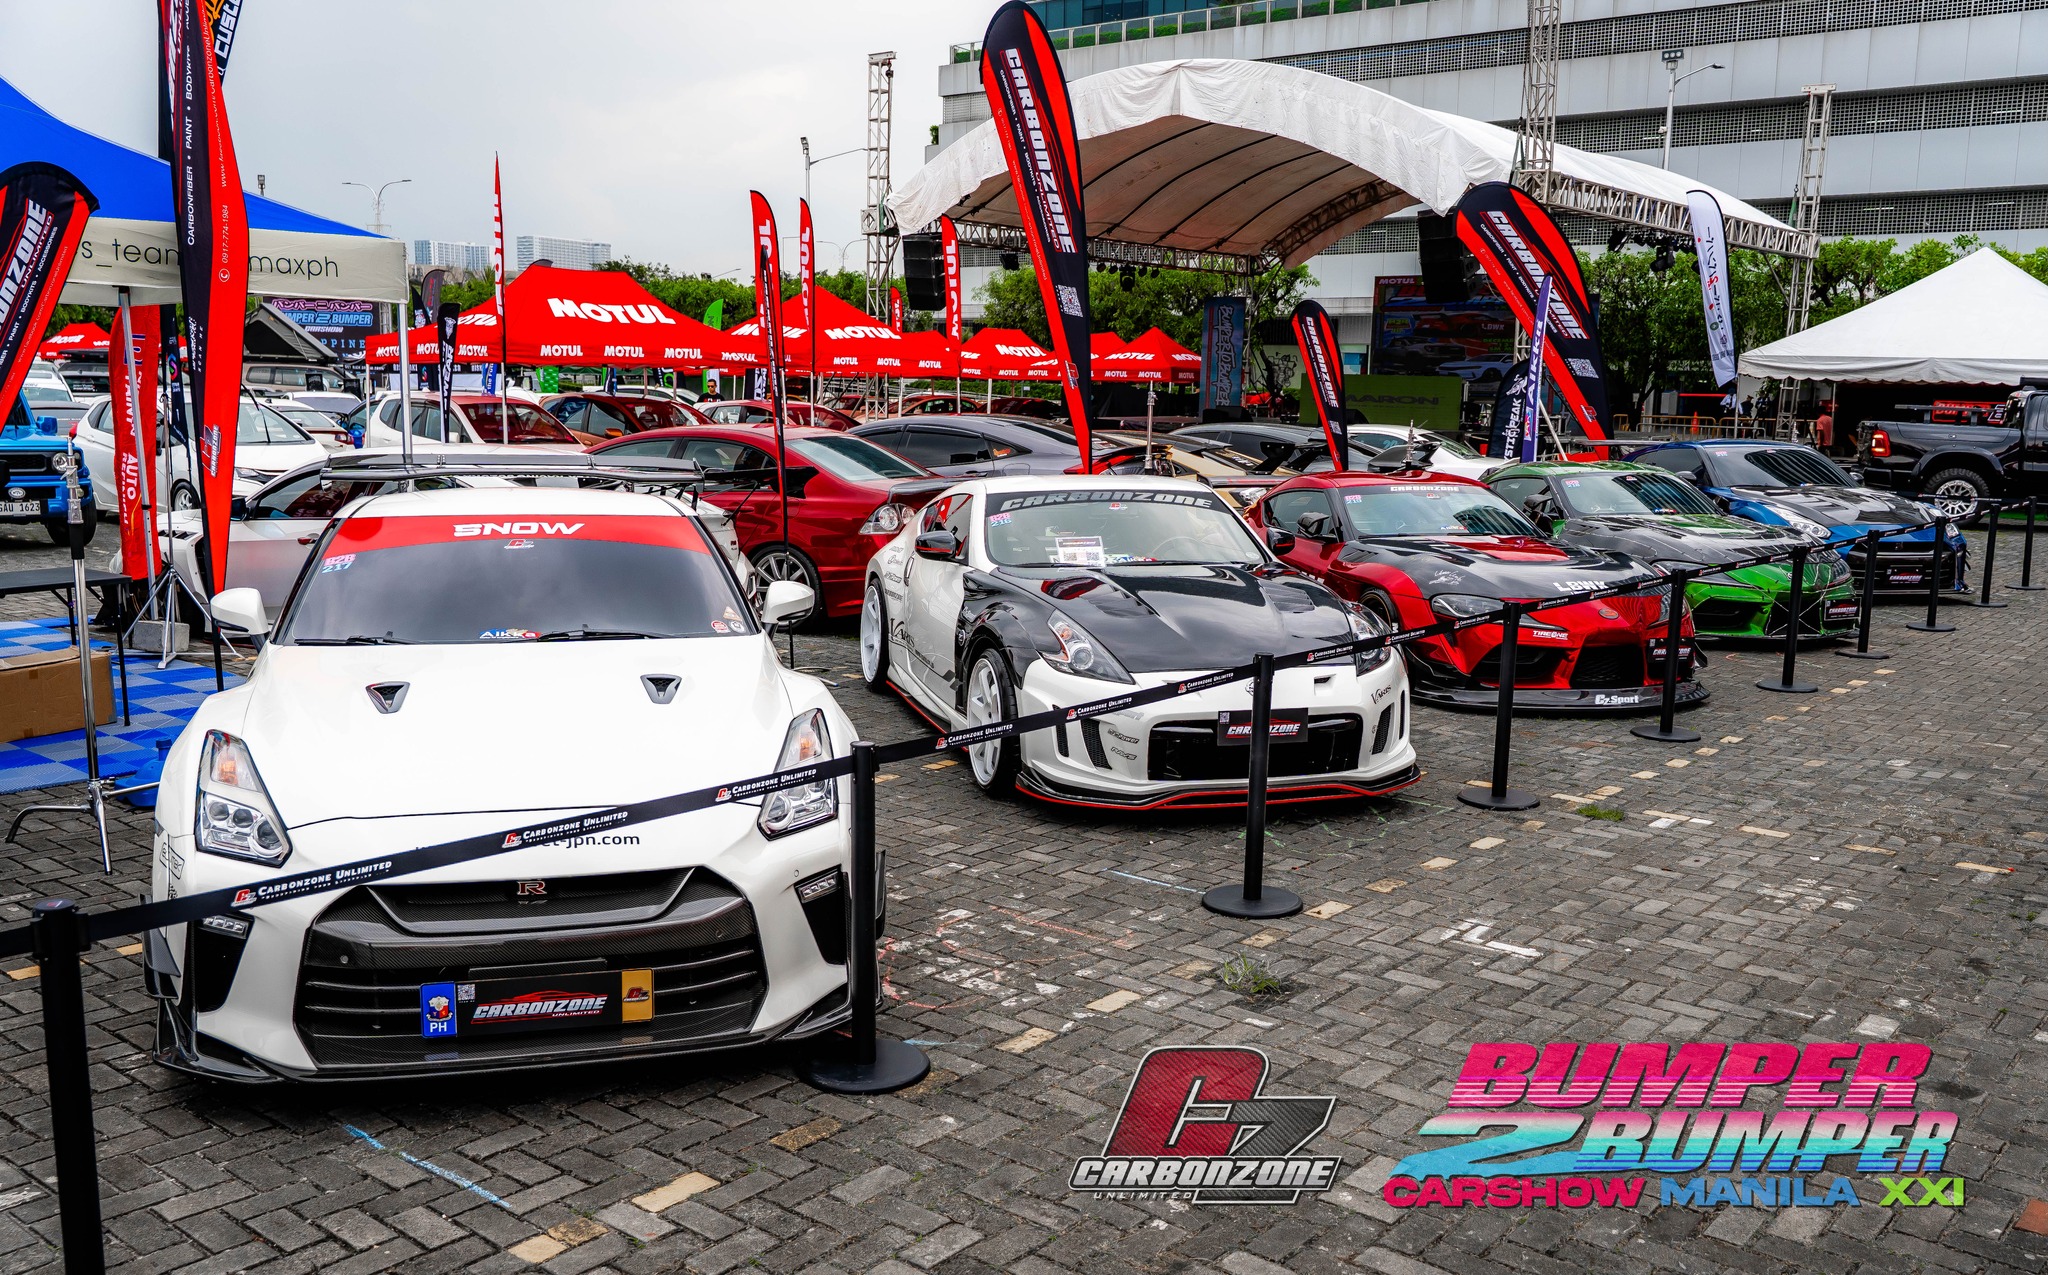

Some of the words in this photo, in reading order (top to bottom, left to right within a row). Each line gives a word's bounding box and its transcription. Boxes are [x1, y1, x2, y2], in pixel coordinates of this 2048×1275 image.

[1005, 48, 1075, 253] CARBONZONE
[187, 165, 195, 246] CARBONFIBER
[1035, 171, 1060, 249] UNLIMITED
[21, 214, 53, 289] UNLIMITED
[21, 280, 38, 313] BODYKITS
[38, 226, 58, 272] ACCESSORIES
[1378, 277, 1415, 285] MOTUL
[547, 297, 676, 325] MOTUL
[315, 313, 331, 324] 2
[331, 313, 373, 325] BUMPER
[824, 325, 901, 340] MOTUL
[376, 346, 400, 357] MOTU
[416, 343, 440, 355] MOTU
[458, 344, 488, 357] MOTUL
[540, 344, 583, 357] MOTUL
[604, 345, 644, 358] MOTUL
[664, 347, 702, 360] MOTUL
[994, 344, 1047, 357] MOTUL
[1104, 352, 1155, 361] MOTUL
[833, 356, 858, 365] MOTUL
[877, 357, 901, 366] MOTUL
[918, 359, 941, 369] MOTUL
[1305, 316, 1339, 408] CARBONZONE
[999, 369, 1019, 377] MOTUL
[1027, 369, 1048, 377] MOTUL
[1104, 370, 1128, 378] MOTUL
[1138, 371, 1162, 379] MOTUL
[1178, 371, 1195, 379] MOTUL
[127, 453, 138, 500] AUTO
[20, 503, 40, 512] 1623
[1000, 491, 1213, 511] CARBONZONE
[989, 512, 1011, 522] B2B
[453, 523, 585, 537] SNOW
[321, 561, 353, 574] 217
[324, 554, 356, 567] B2B
[1552, 581, 1608, 593] LBWK
[1828, 606, 1858, 614] CARBONZONE
[1186, 678, 1212, 689] CARBONZONE
[1213, 672, 1234, 681] UNLIMITED
[1077, 702, 1107, 714] CARBONZONE
[1108, 697, 1132, 707] UNLIMITED
[948, 729, 984, 744] CARBONZONE
[985, 723, 1013, 734] UNLIMITED
[732, 777, 778, 794] CARBONZONE
[781, 769, 817, 782] UNLIMITED
[523, 821, 581, 840] CARBONZONE
[583, 811, 628, 827] UNLIMITED
[258, 873, 332, 896] CARBONZONE
[335, 861, 392, 879] UNLIMITED
[473, 996, 608, 1019] CARBONZONE
[552, 1009, 600, 1017] UNLIMITED
[430, 1022, 447, 1033] PH
